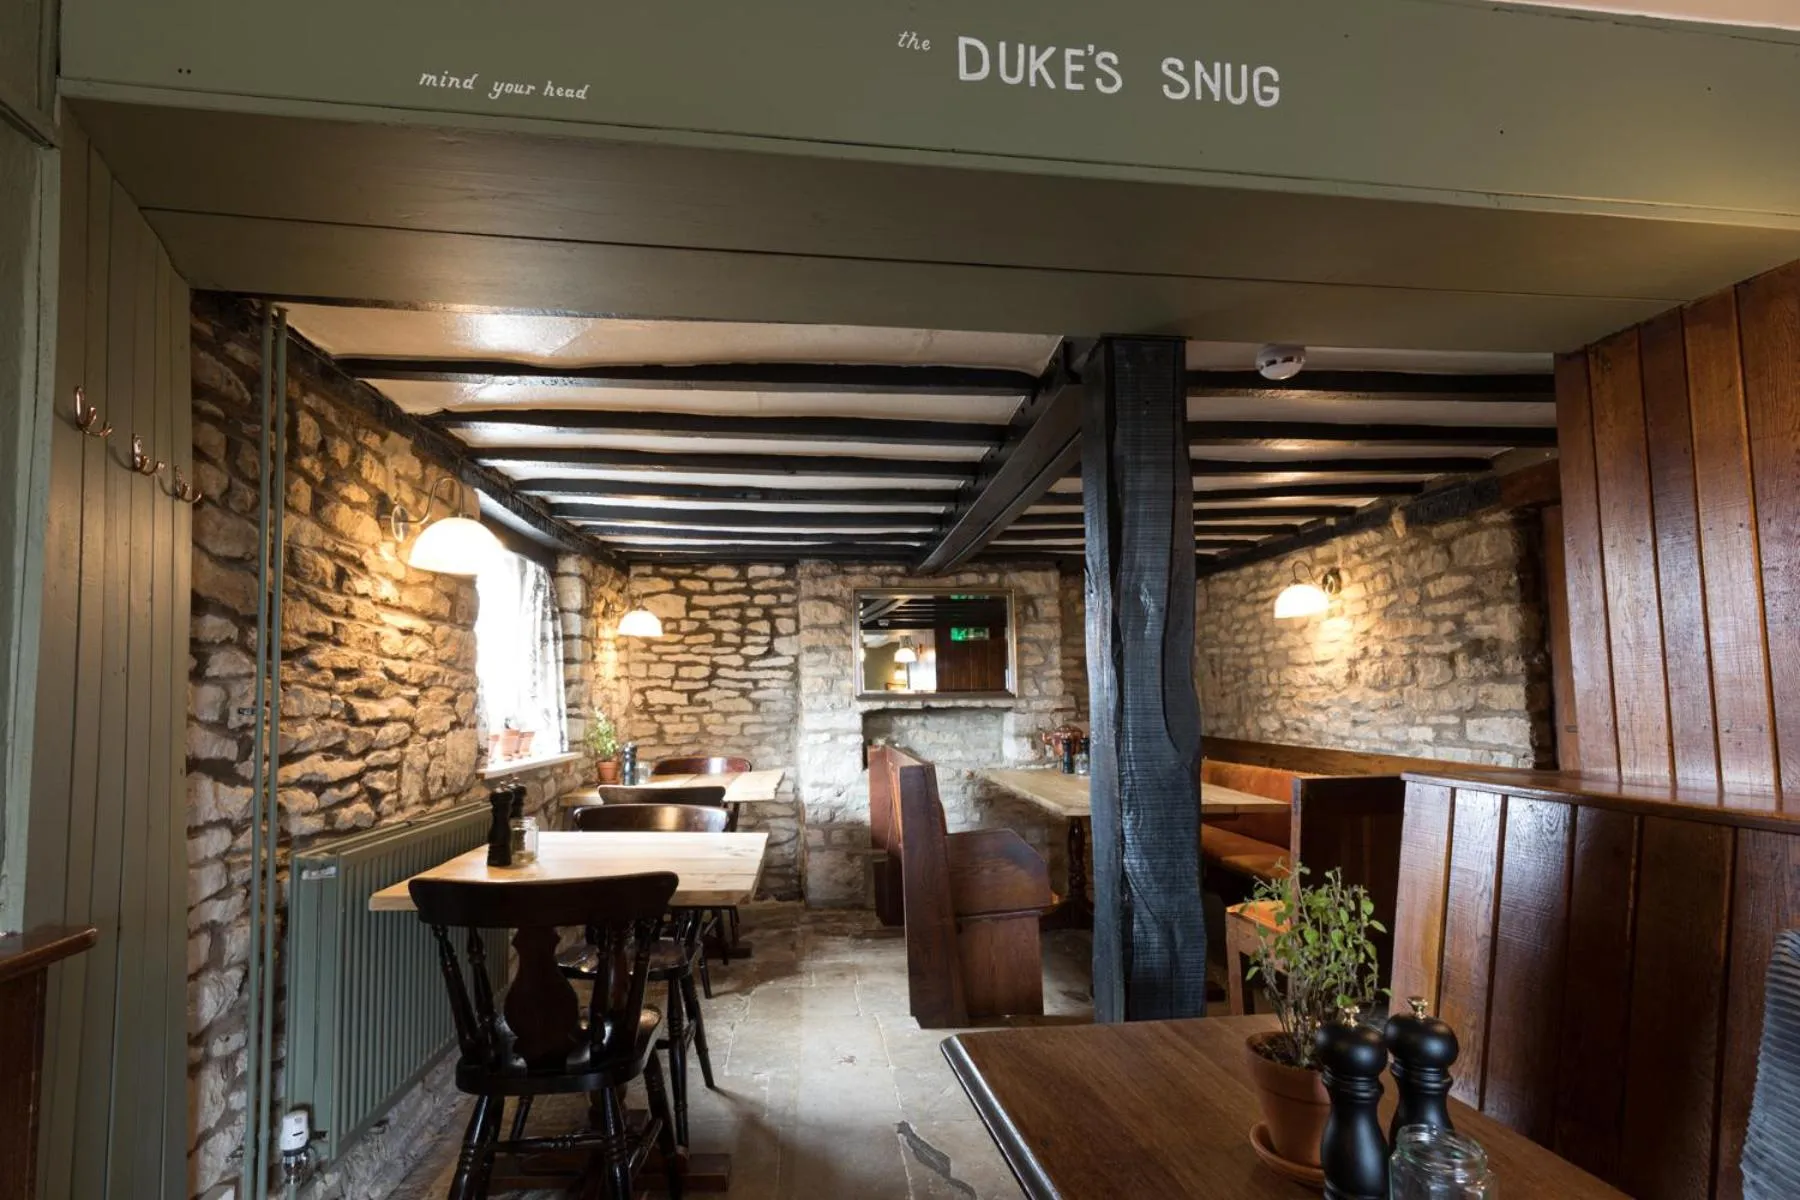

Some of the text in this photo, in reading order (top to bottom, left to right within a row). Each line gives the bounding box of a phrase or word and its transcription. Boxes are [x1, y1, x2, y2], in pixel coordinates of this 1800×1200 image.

[418, 71, 591, 100] mind your head
[897, 30, 1281, 108] the DUKE'S SNUG
